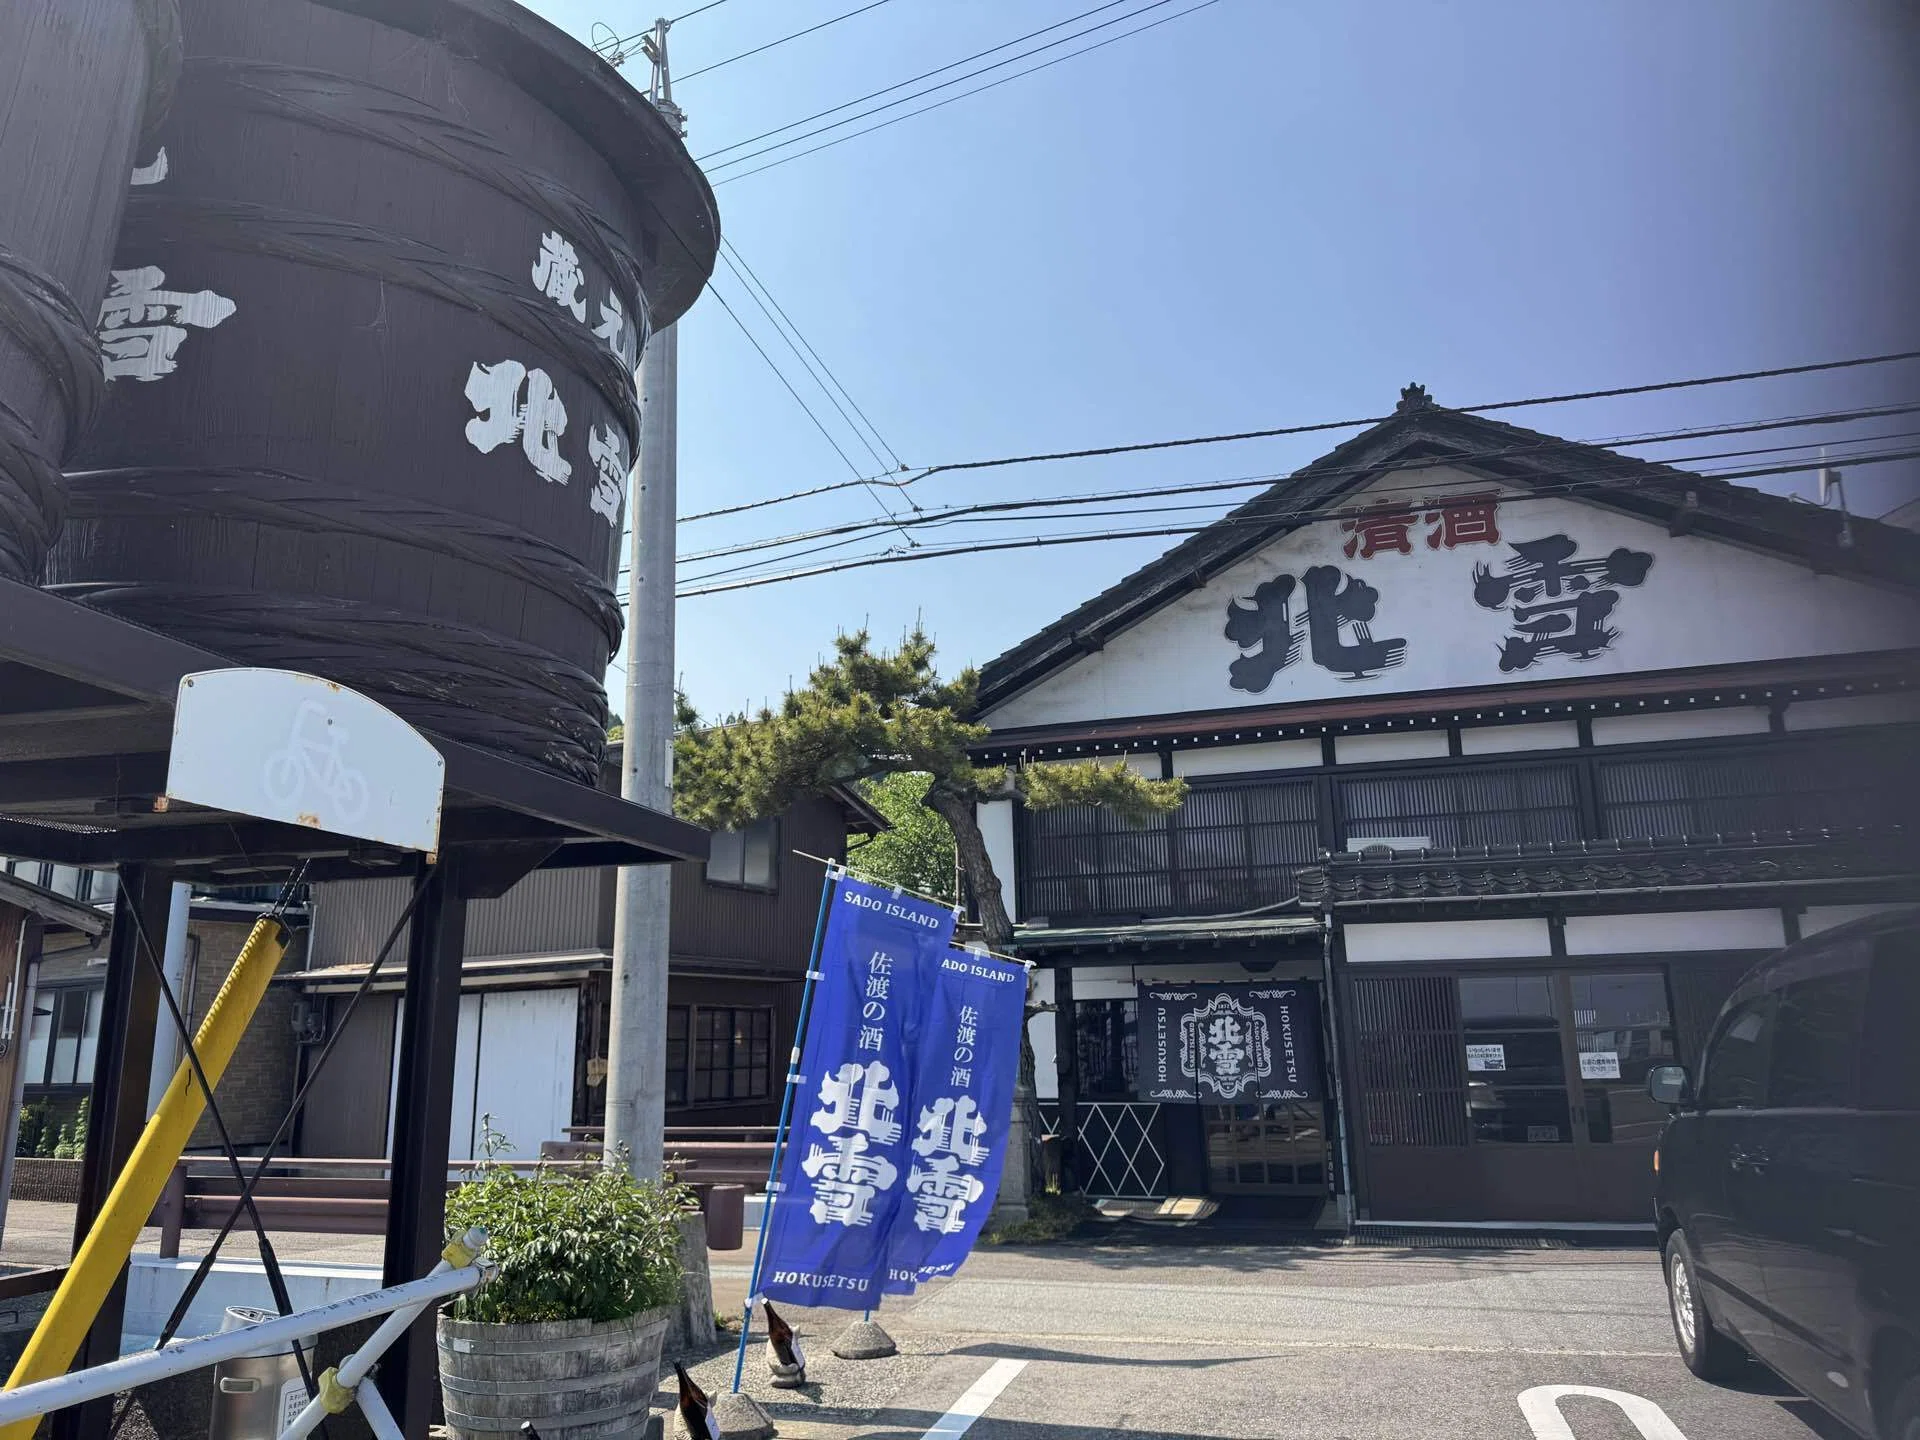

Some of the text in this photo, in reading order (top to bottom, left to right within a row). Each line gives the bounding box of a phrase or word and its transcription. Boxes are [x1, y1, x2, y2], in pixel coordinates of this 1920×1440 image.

[1341, 492, 1502, 561] 清酒
[1225, 534, 1654, 693] 北雪
[843, 890, 940, 929] SADO ISLAND
[858, 950, 894, 1052] 佐渡の酒
[941, 958, 1016, 983] ADO ISLAND
[950, 1005, 979, 1088] 佐渡の酒
[1157, 1007, 1167, 1083] HOKUSETSU
[1208, 1016, 1245, 1075] 北雪
[1279, 1005, 1297, 1084] HOKUSETSU
[801, 1060, 902, 1228] 北雪
[906, 1094, 990, 1235] 北雪
[772, 1270, 869, 1292] HOKUSETSU
